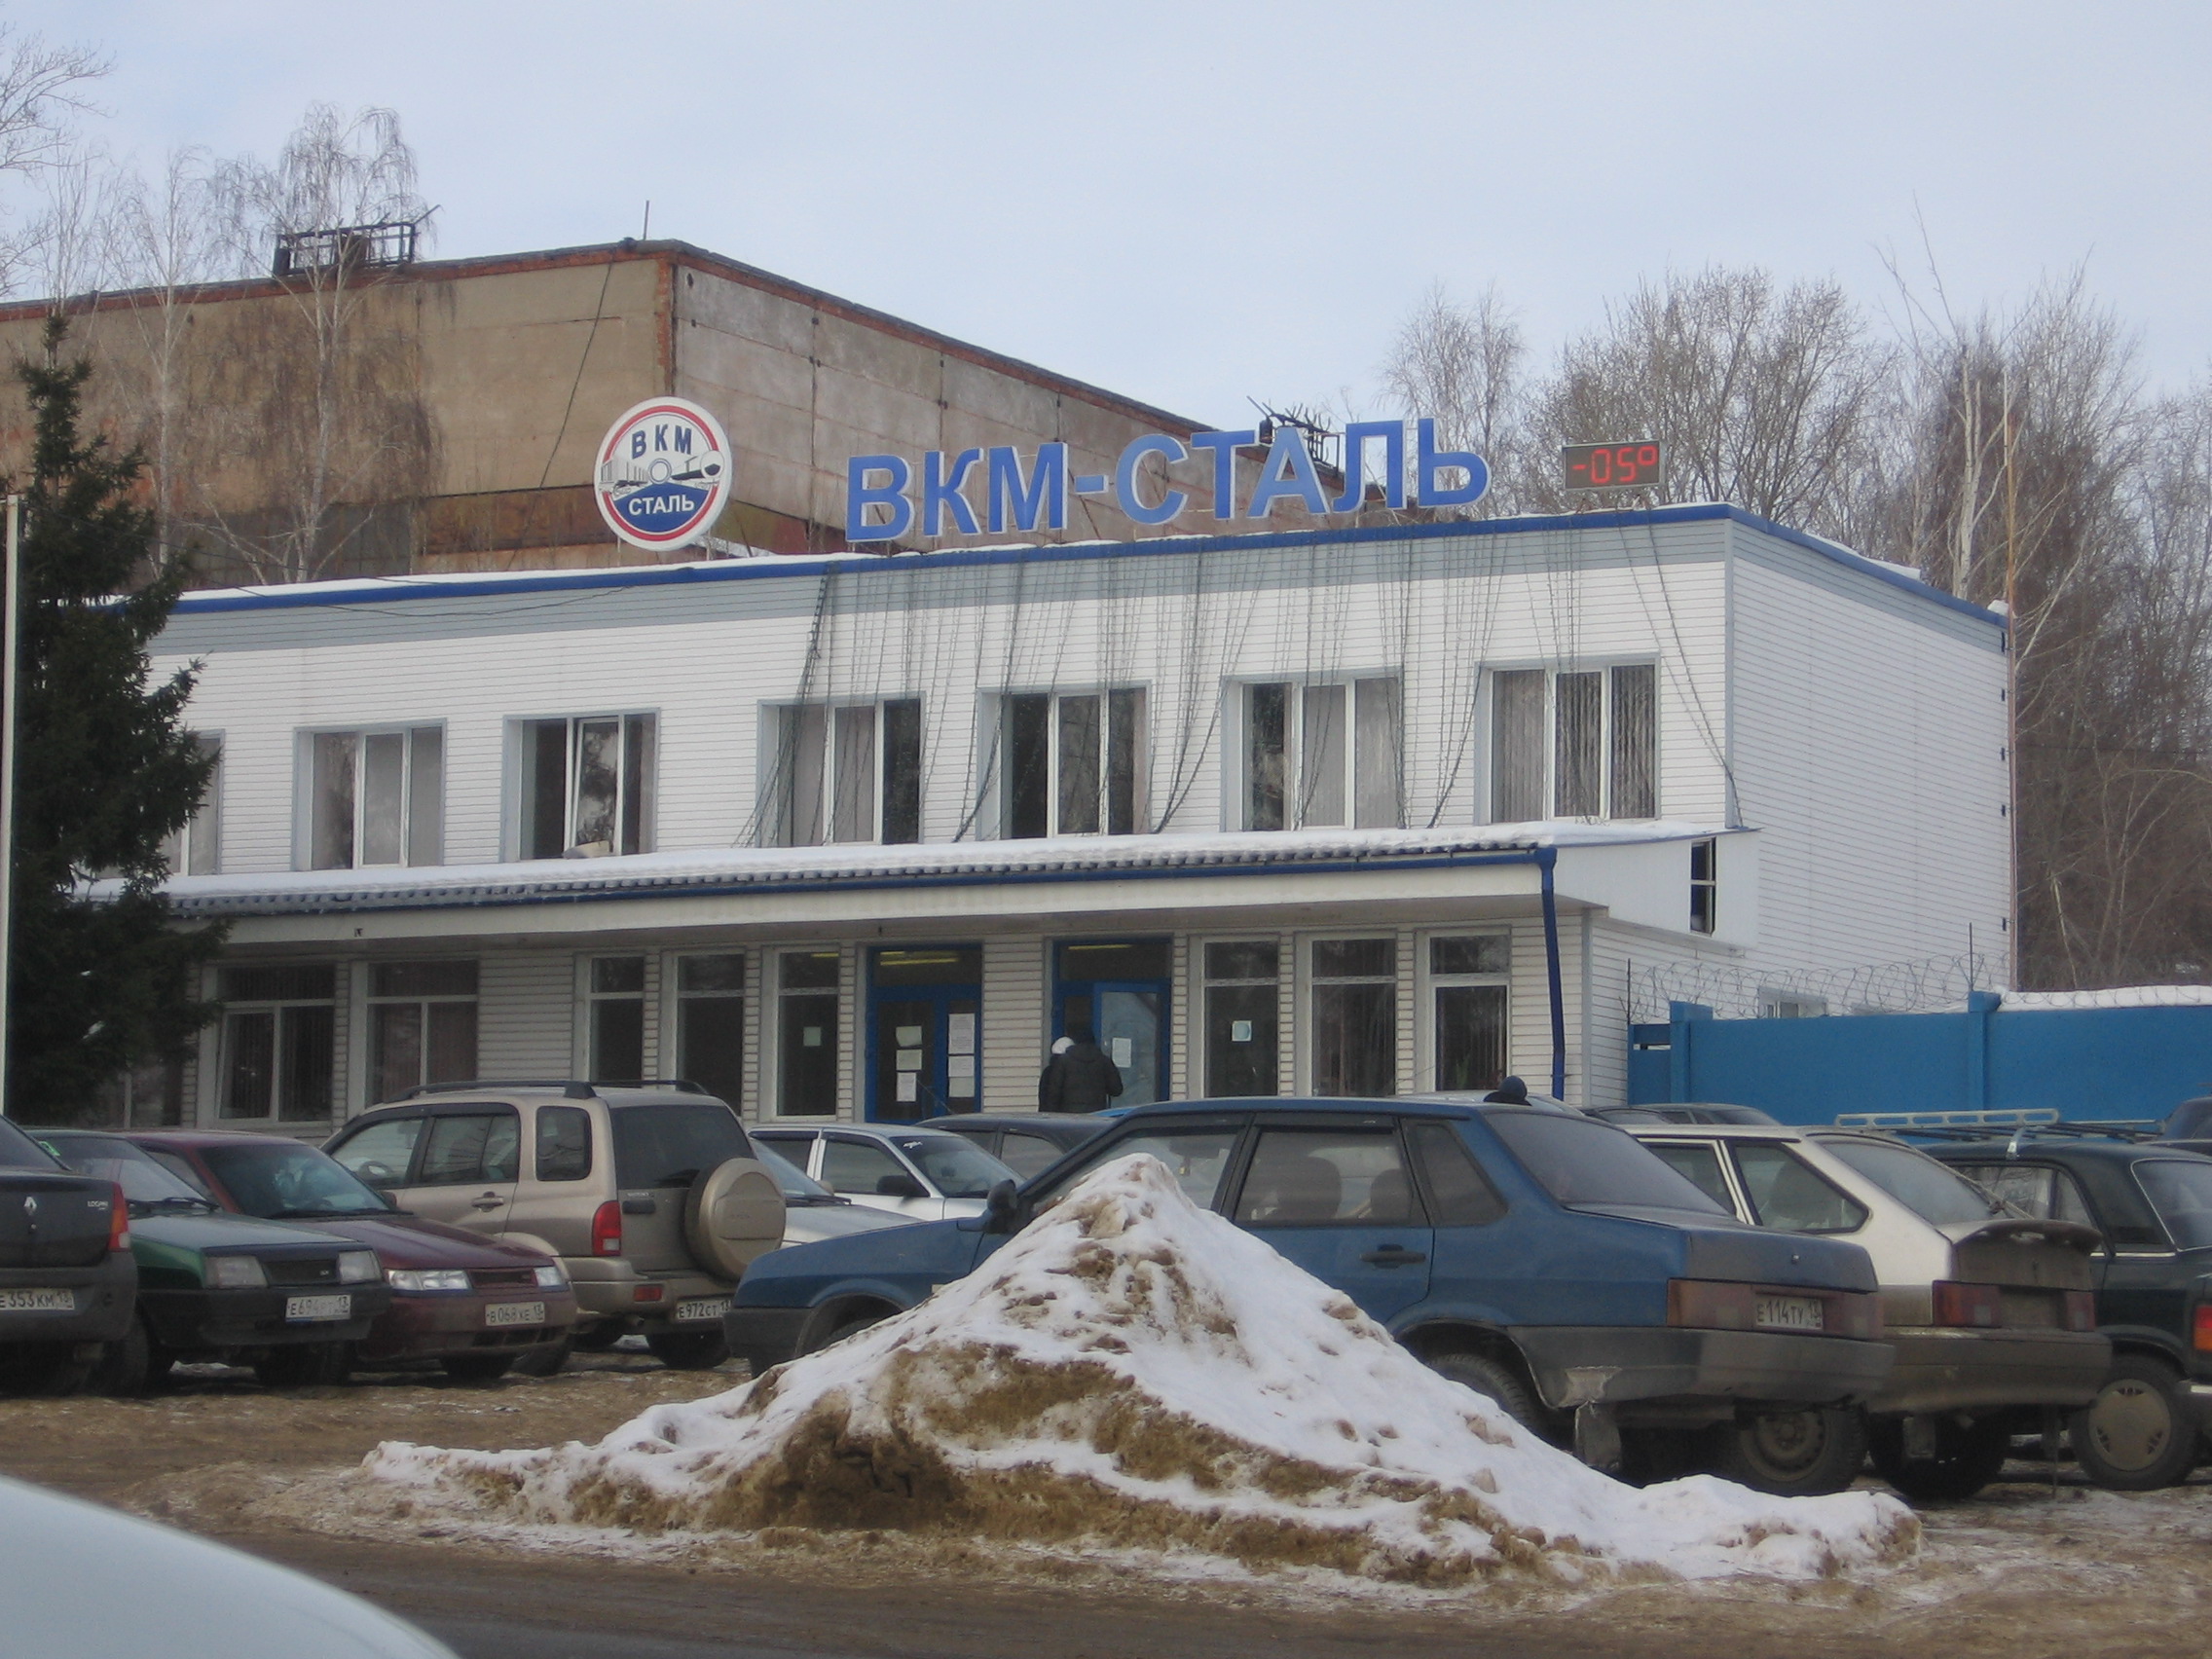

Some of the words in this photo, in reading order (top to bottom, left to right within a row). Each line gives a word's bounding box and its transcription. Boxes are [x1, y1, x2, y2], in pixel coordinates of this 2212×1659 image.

[632, 424, 692, 460] ВКМ
[845, 418, 1491, 542] ВКМ-СТАЛЬ
[628, 495, 695, 516] СТАЛЬ
